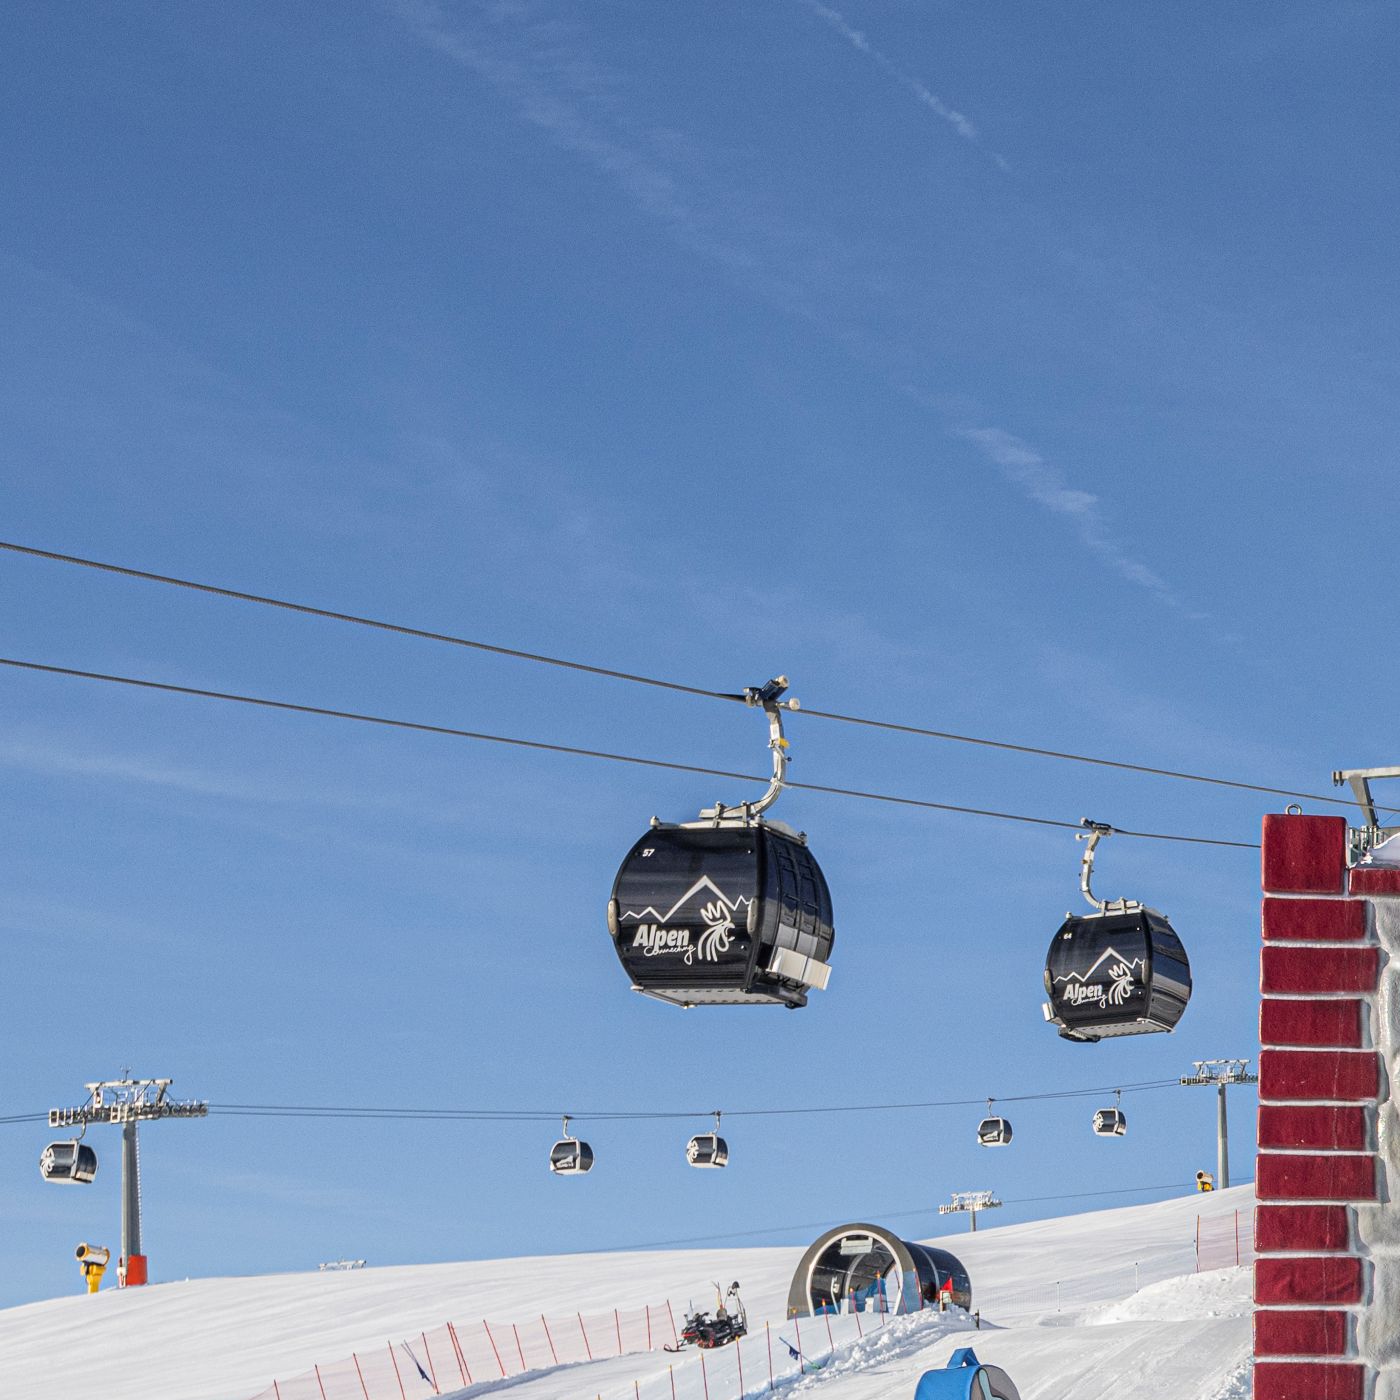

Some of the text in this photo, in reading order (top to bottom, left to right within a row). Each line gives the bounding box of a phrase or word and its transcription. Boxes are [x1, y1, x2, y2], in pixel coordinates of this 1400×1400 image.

[642, 848, 655, 857] 57
[632, 924, 690, 949] Alpen
[1063, 983, 1103, 1001] Alpen
